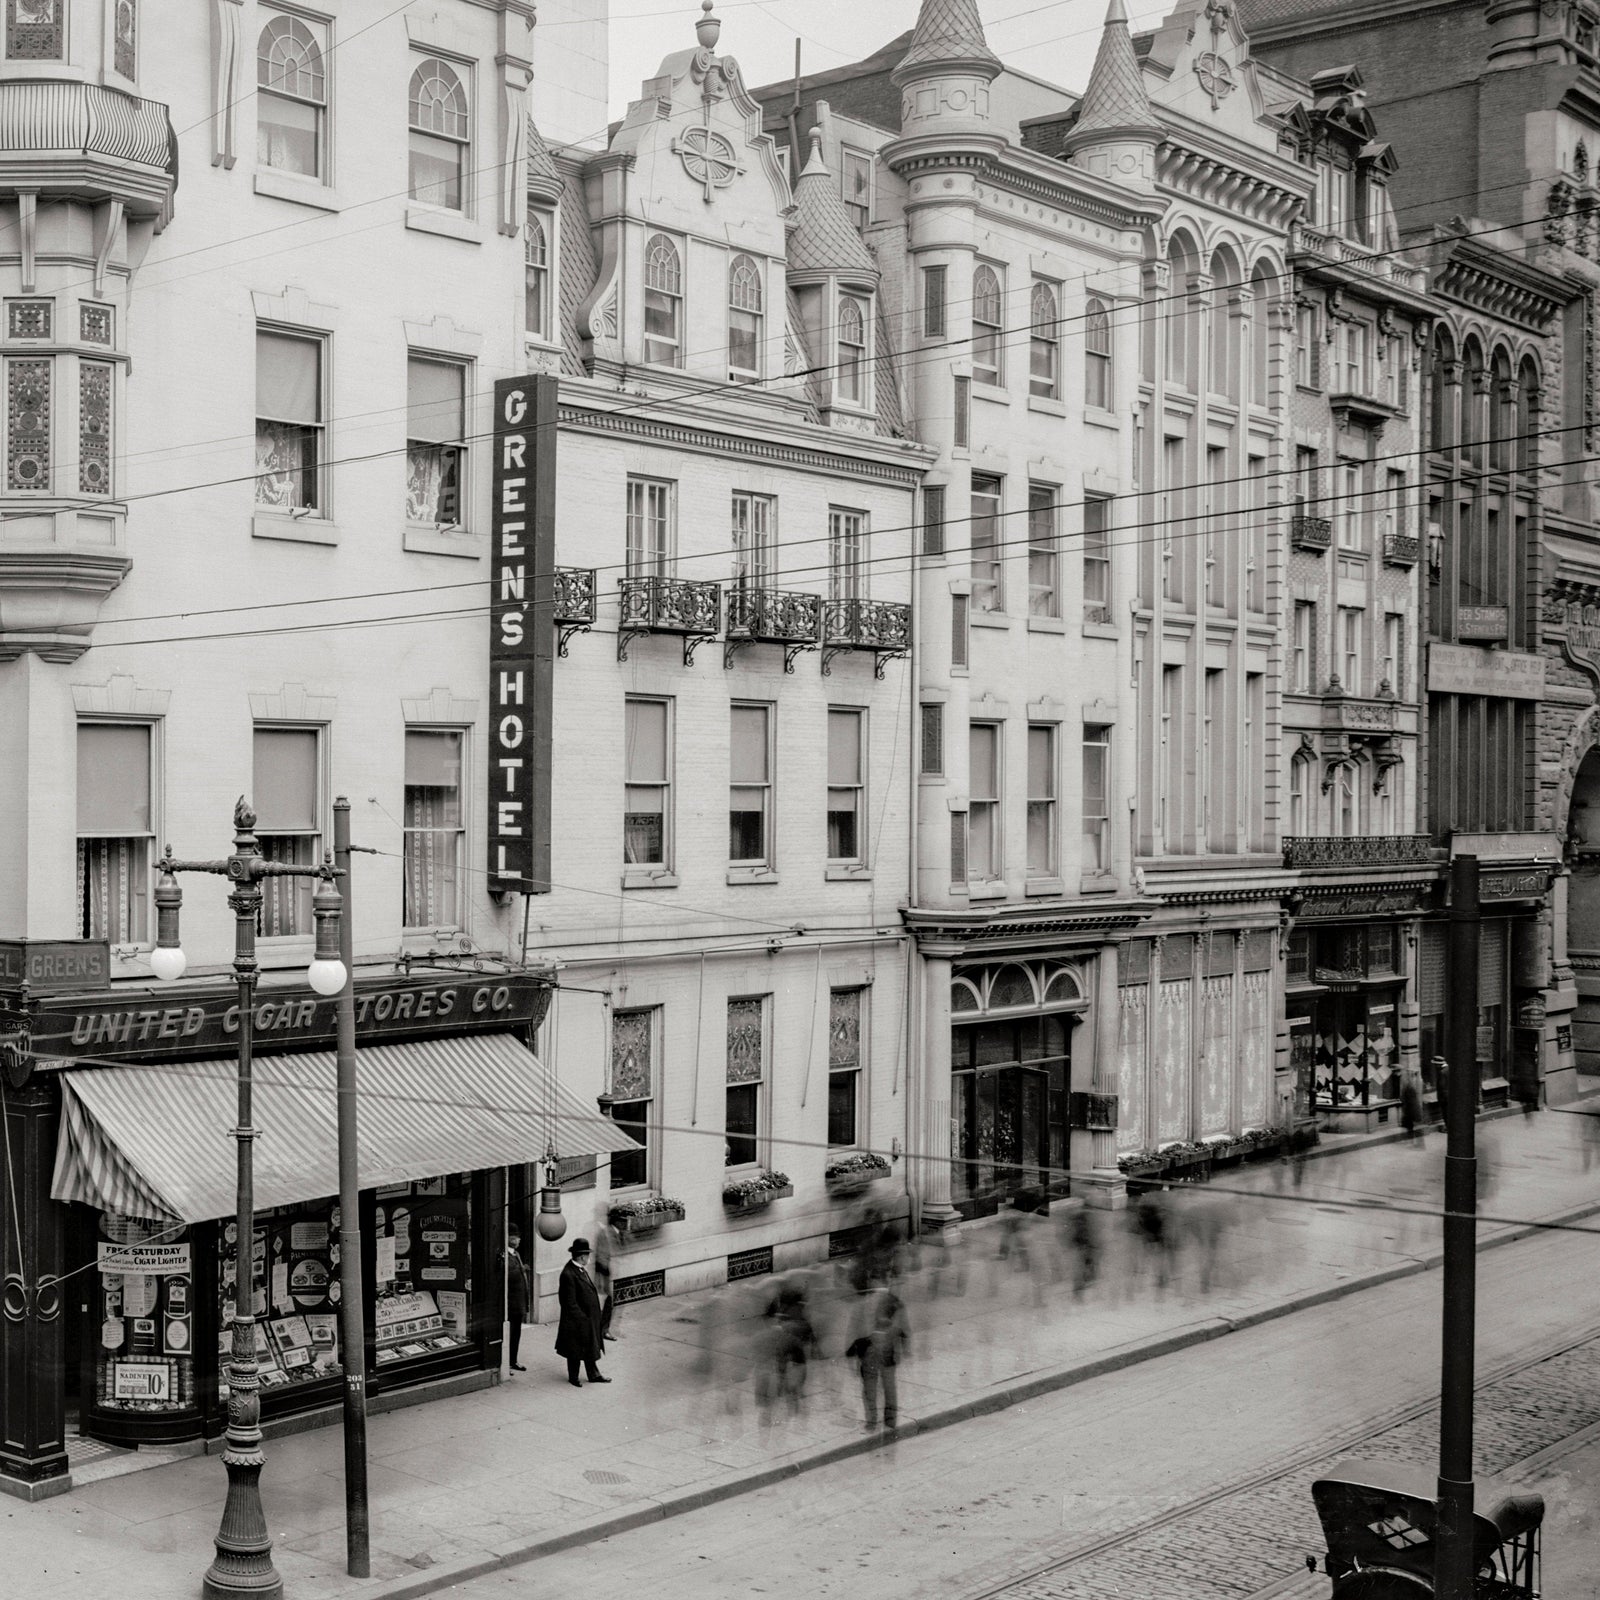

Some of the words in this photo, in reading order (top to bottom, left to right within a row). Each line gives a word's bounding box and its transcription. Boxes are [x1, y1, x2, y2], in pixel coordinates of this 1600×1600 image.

[500, 389, 528, 646] GREEN'S
[497, 671, 524, 879] HOTEL
[71, 1007, 205, 1046] UNITED
[223, 1000, 317, 1033] CGAR
[331, 990, 457, 1025] TORES
[472, 987, 513, 1013] CO.
[106, 1246, 129, 1255] FREE
[132, 1247, 181, 1255] SATURDAY
[134, 1256, 157, 1265] CIGAR
[158, 1256, 187, 1265] LIGHTER
[119, 1372, 147, 1380] NADINE
